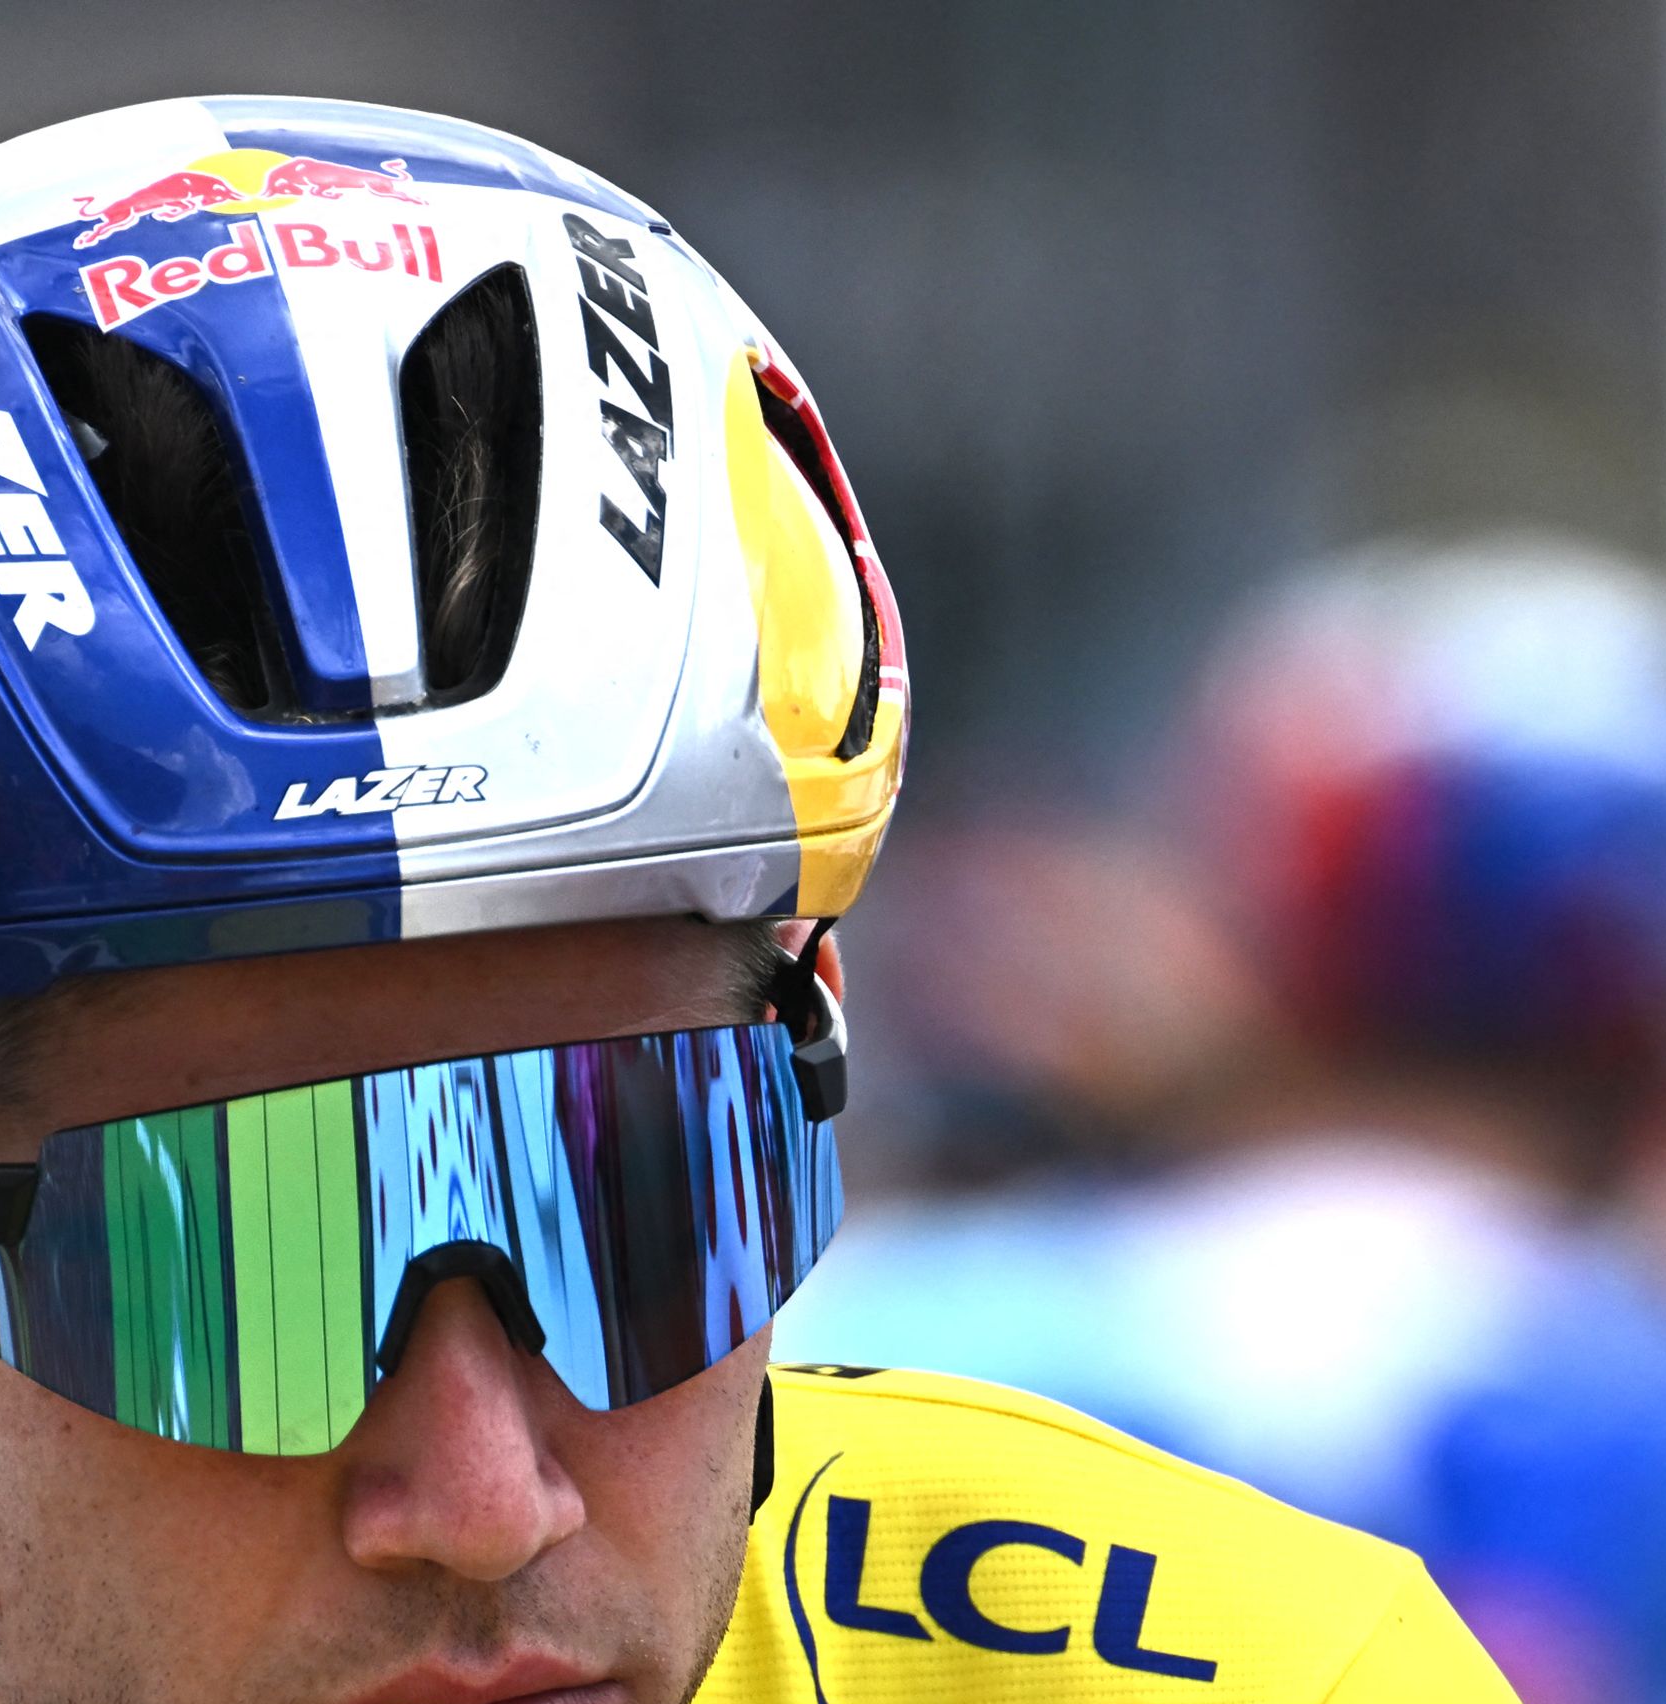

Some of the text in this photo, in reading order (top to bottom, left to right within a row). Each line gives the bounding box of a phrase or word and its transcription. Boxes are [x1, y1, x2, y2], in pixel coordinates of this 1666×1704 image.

[83, 222, 444, 328] Red Bull
[564, 211, 675, 589] LAZER
[273, 763, 489, 822] LAZER
[824, 1493, 1219, 1683] LCL
